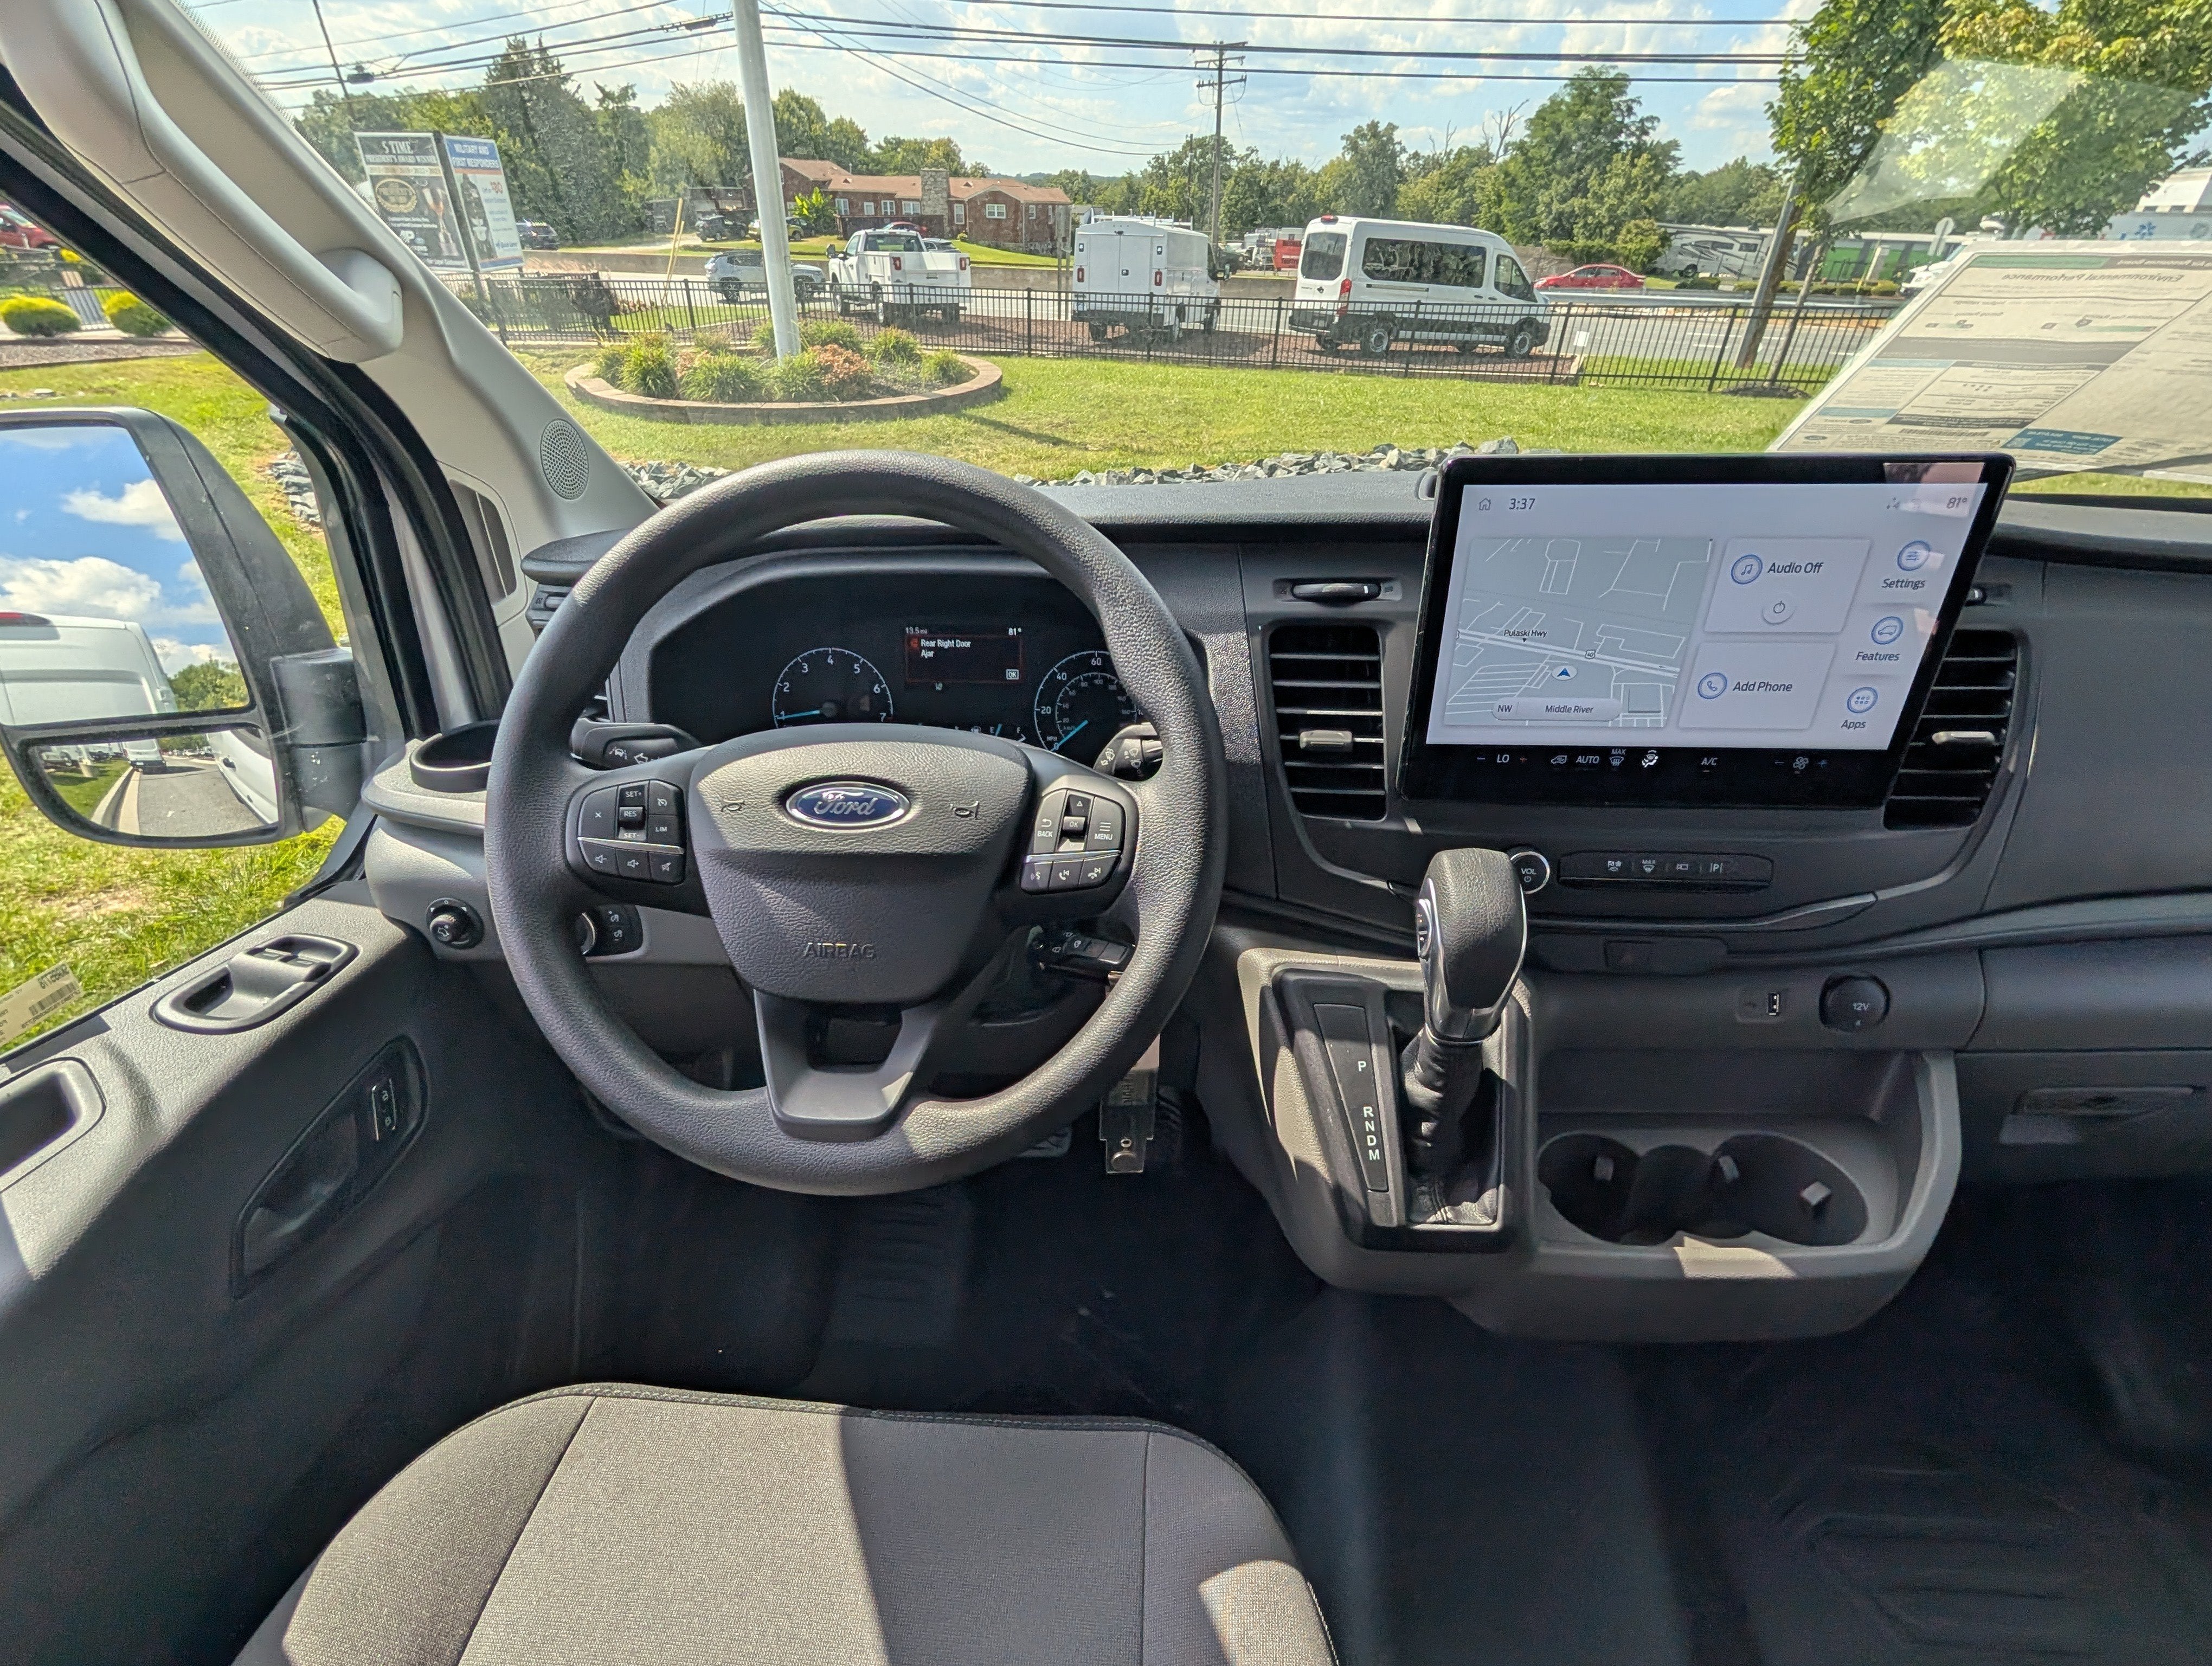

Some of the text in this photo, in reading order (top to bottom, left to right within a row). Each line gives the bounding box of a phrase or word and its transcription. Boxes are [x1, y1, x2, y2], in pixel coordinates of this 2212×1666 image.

[1509, 498, 1535, 510] 3:37
[1946, 497, 1968, 509] 81°
[1768, 562, 1823, 574] Audio Off
[1882, 579, 1925, 590] Settings
[1504, 629, 1547, 638] Pulaski Hwy
[921, 639, 971, 649] Rear Right Door
[921, 650, 935, 659] Ajar
[1856, 651, 1900, 662] Features
[827, 655, 834, 665] 4
[1091, 657, 1102, 665] 60
[802, 663, 808, 674] 3
[854, 664, 860, 674] 5
[1057, 672, 1067, 681] 40
[783, 682, 790, 693] 2
[873, 684, 880, 694] 6
[1733, 682, 1793, 693] Add Phone
[1041, 706, 1051, 714] 20
[1497, 704, 1513, 713] NW
[1545, 704, 1594, 714] Middle River
[880, 713, 886, 722] 7
[1841, 720, 1866, 730] Apps
[1497, 754, 1509, 764] LO
[1576, 755, 1599, 764] AUTO
[1701, 757, 1719, 766] A/C
[625, 790, 642, 799] SET+
[814, 790, 876, 816] Ford
[1037, 830, 1053, 838] BACK
[1094, 833, 1113, 842] MENU
[802, 941, 877, 960] AIRBAG
[1853, 1002, 1870, 1011] 12V
[1358, 1061, 1366, 1072] P
[1363, 1106, 1374, 1118] R
[1365, 1120, 1375, 1132] N
[1367, 1135, 1377, 1146] D
[1368, 1149, 1380, 1161] M
